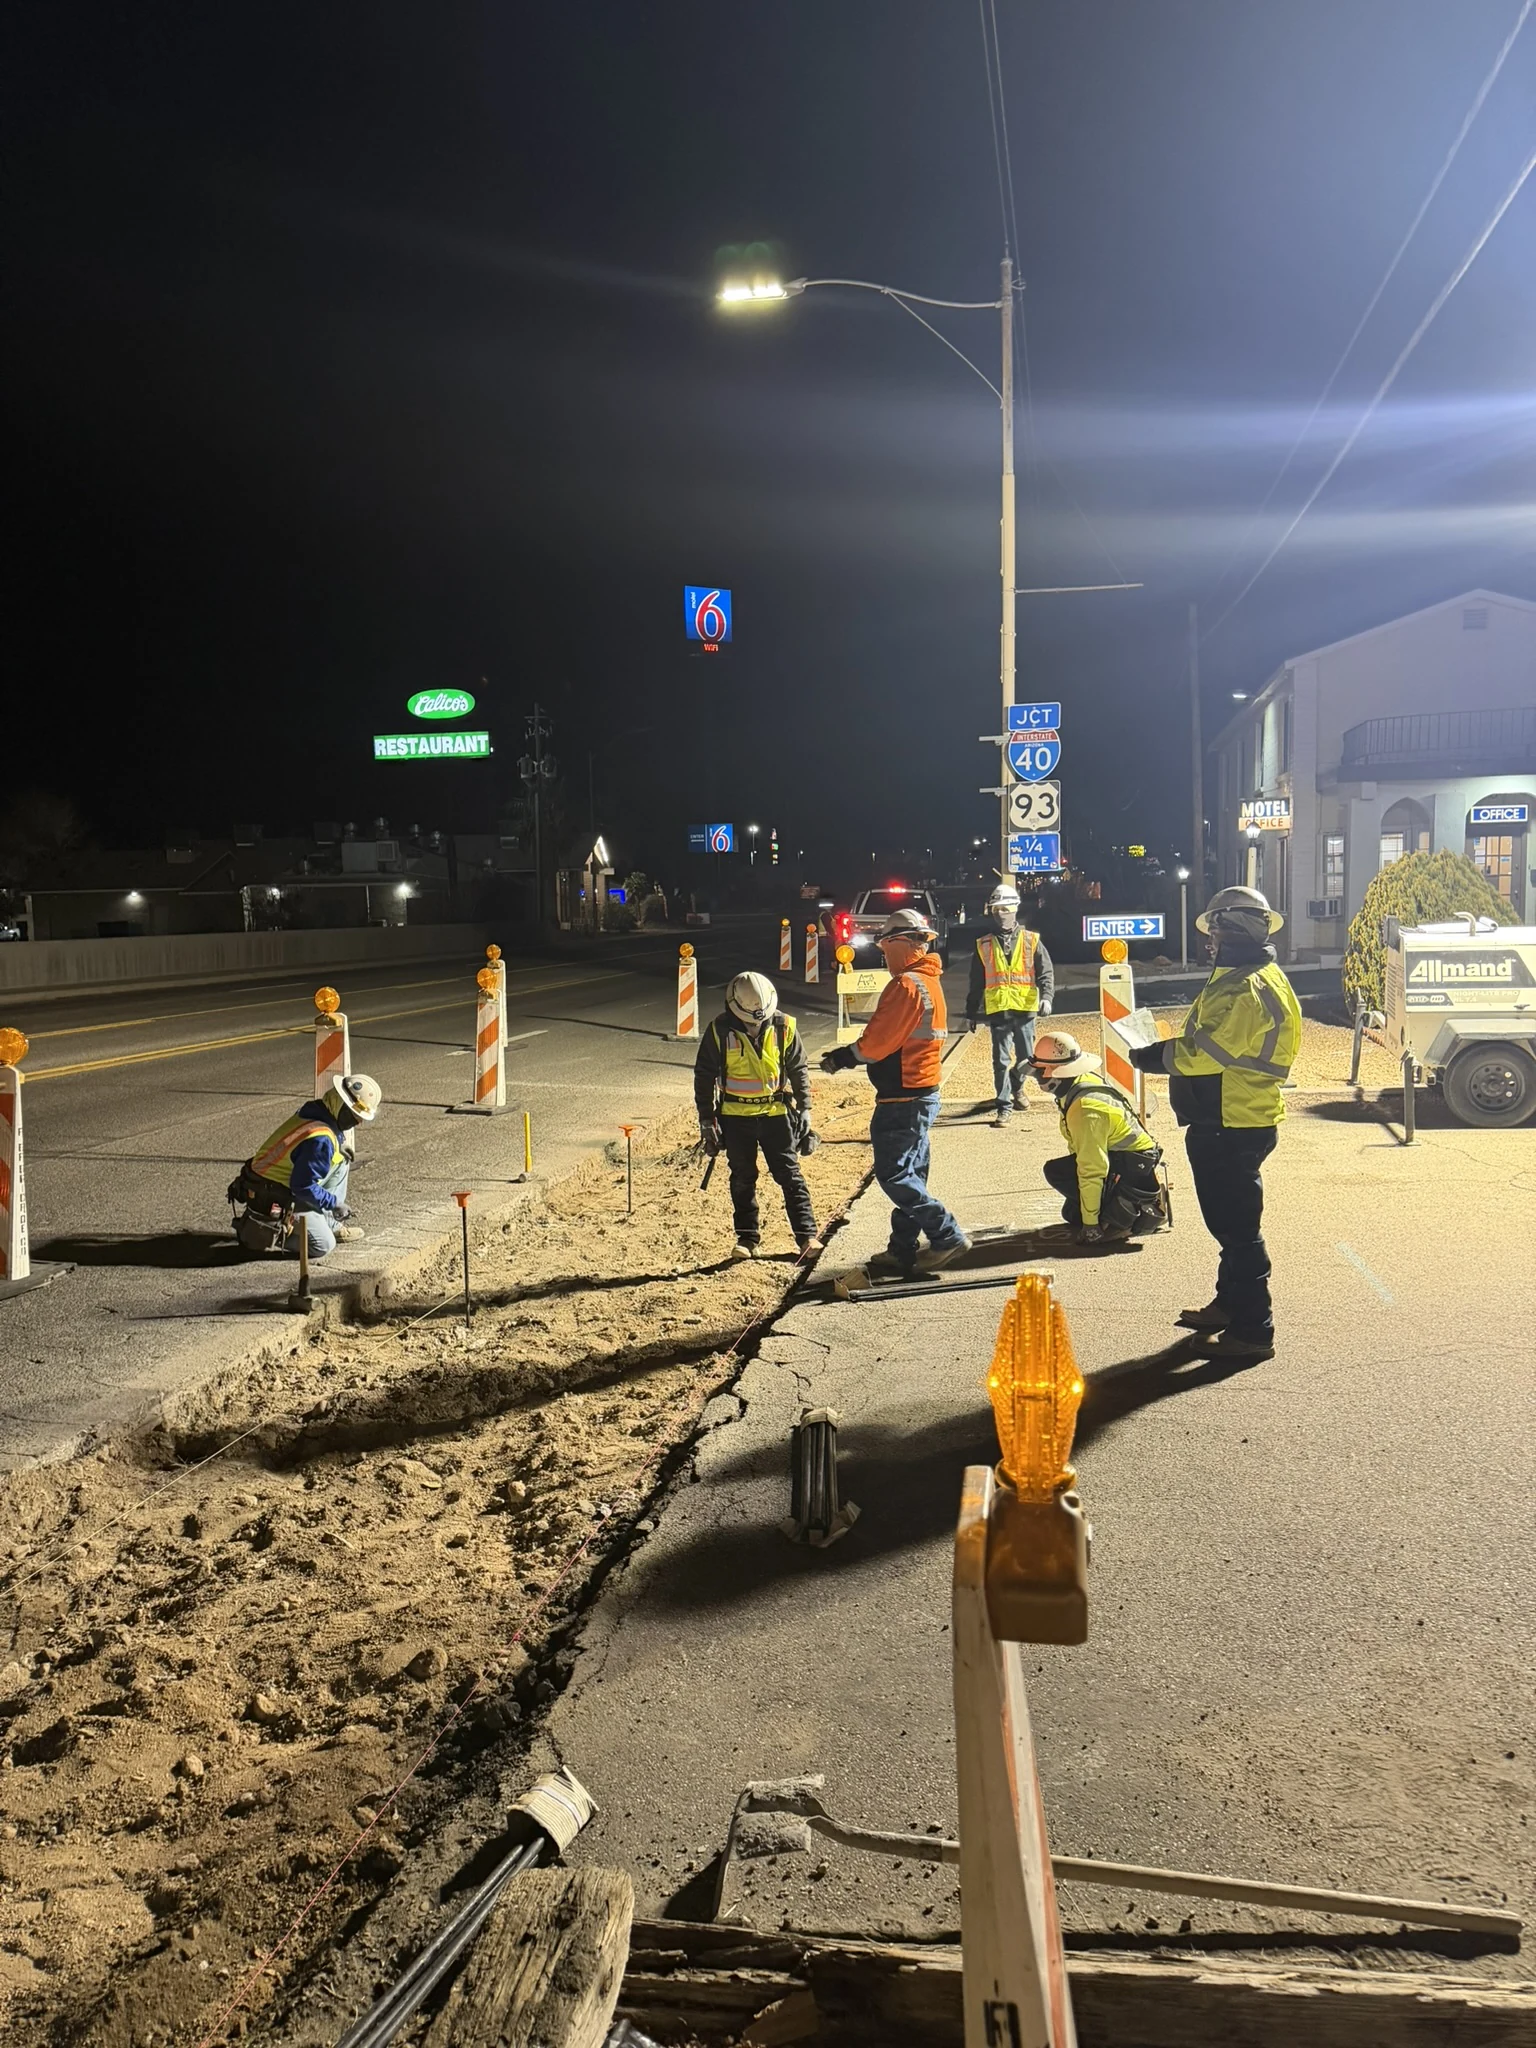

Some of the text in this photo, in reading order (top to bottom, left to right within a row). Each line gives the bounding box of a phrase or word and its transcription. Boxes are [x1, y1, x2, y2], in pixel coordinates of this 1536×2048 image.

[695, 590, 727, 641] 6
[414, 692, 469, 716] Calico's
[1016, 708, 1053, 725] JCT
[374, 735, 489, 756] RESTAURANT
[1016, 733, 1053, 741] INTERSTATE
[1015, 746, 1052, 771] 40
[1015, 792, 1055, 819] 93
[1241, 799, 1289, 818] MOTEL
[1479, 808, 1520, 820] OFFICE
[1245, 818, 1284, 827] OFICE
[712, 825, 731, 853] 6
[1019, 856, 1049, 867] MILE
[1091, 920, 1135, 935] ENTER
[1409, 959, 1512, 982] Allmand
